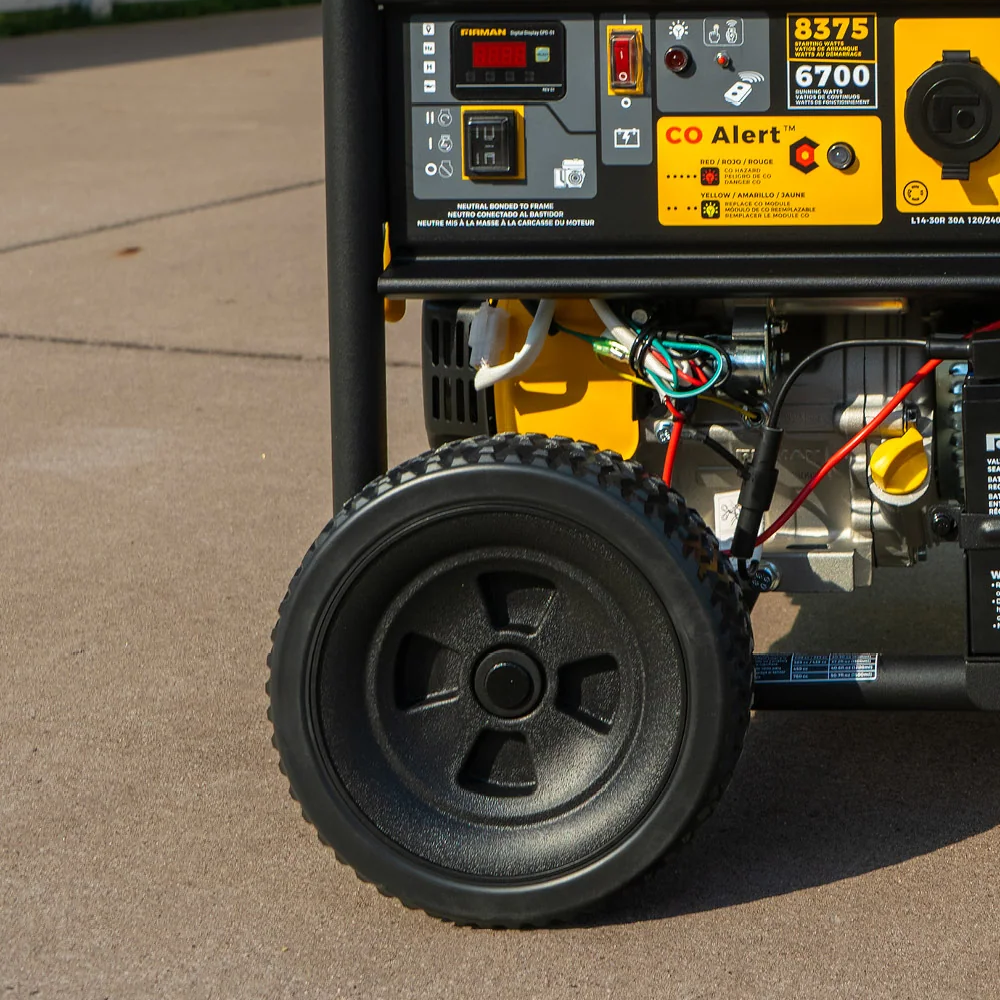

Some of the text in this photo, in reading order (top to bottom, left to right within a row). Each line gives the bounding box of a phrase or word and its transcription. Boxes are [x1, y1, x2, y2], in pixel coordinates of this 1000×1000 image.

[794, 17, 869, 40] 8375
[795, 65, 870, 87] 6700
[666, 125, 703, 144] CO
[459, 218, 464, 226] À
[501, 218, 506, 226] À
